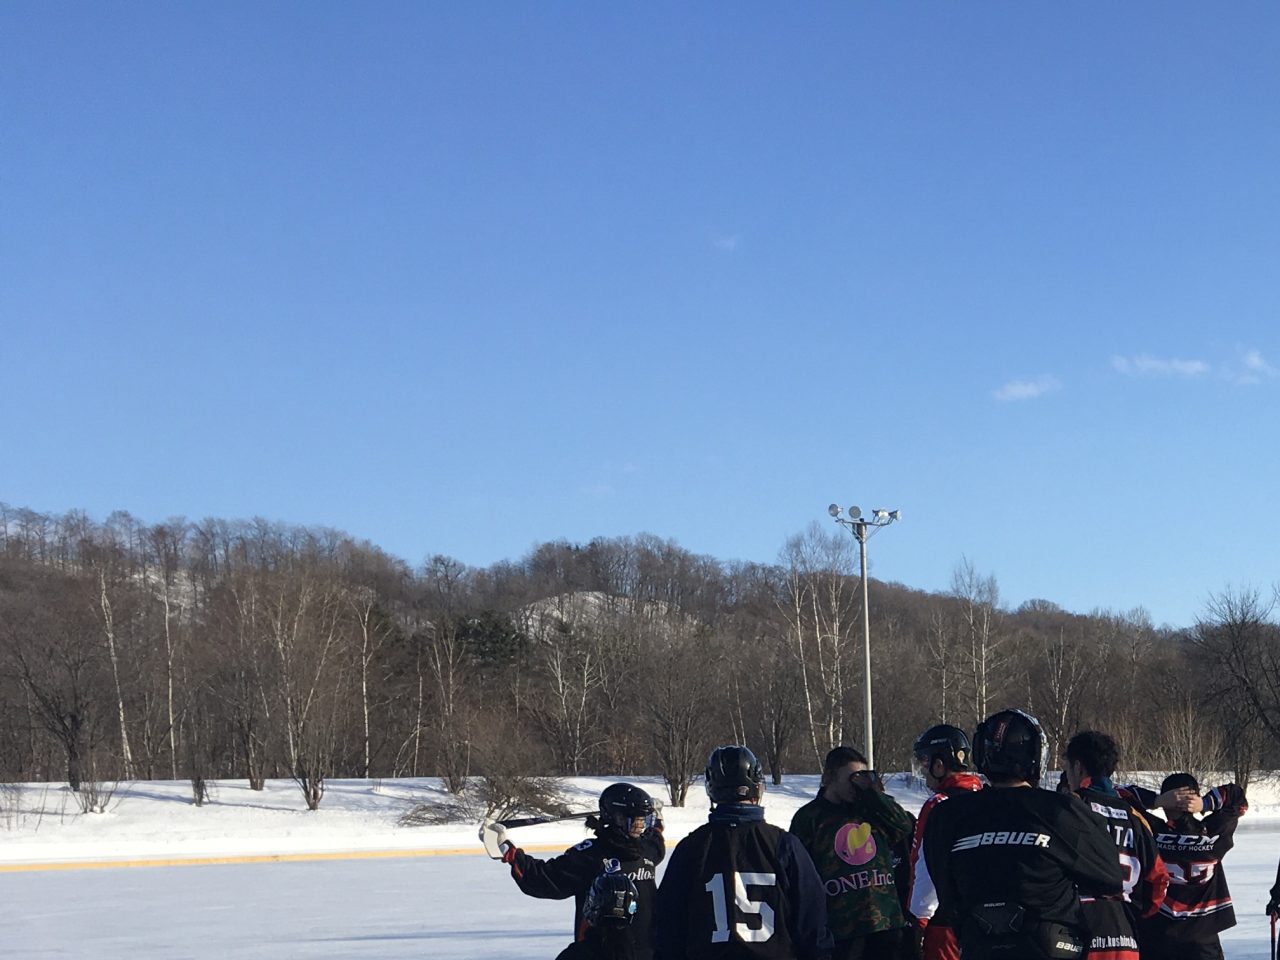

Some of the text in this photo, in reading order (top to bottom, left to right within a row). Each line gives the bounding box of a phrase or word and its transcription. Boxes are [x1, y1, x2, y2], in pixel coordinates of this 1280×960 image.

[980, 831, 1051, 848] BAUER
[1155, 832, 1221, 846] CCM
[1156, 843, 1176, 851] MADE
[1188, 844, 1215, 852] HOCKEY
[824, 869, 895, 896] ONE Inc.
[704, 871, 777, 944] 15
